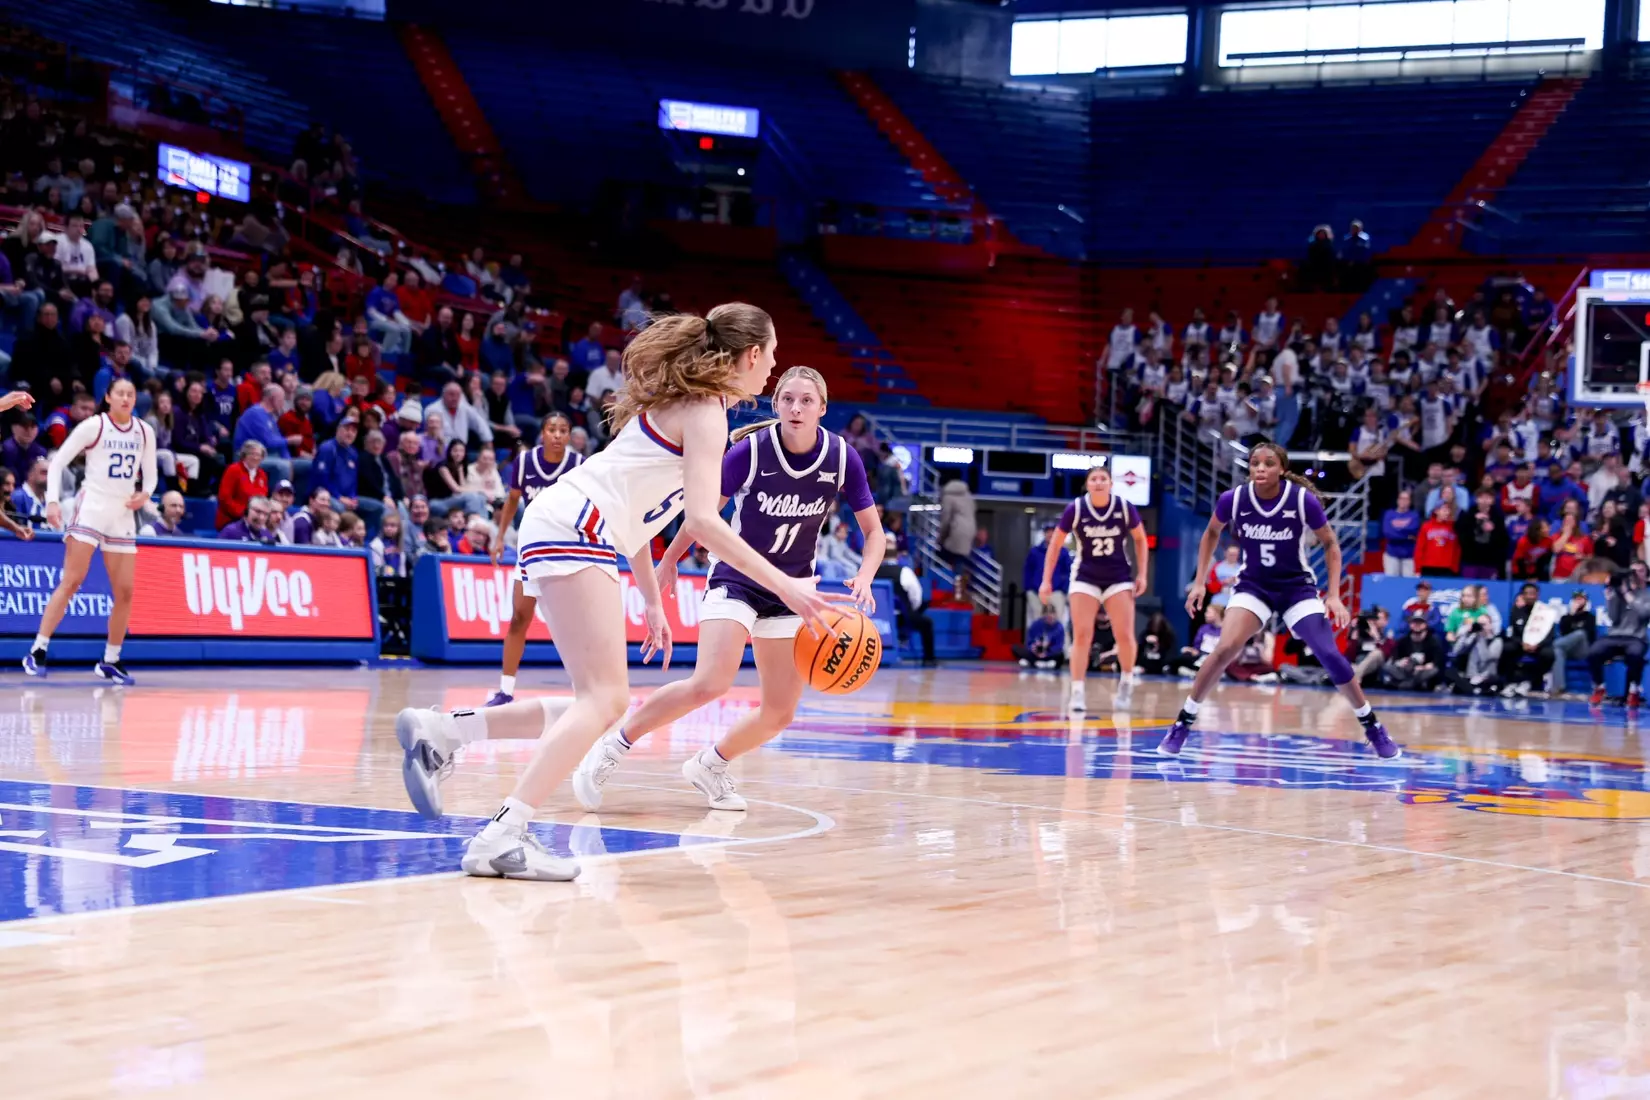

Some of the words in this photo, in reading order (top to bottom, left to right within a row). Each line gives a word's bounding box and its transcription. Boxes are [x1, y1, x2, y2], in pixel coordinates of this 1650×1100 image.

[108, 453, 136, 478] 23
[757, 491, 826, 517] Wildcats
[768, 522, 802, 554] 11
[1242, 522, 1293, 540] Wildcats
[1092, 537, 1115, 557] 23
[1260, 543, 1277, 568] 5
[64, 592, 114, 617] YSTE
[822, 631, 853, 675] NCAA
[841, 637, 876, 689] Wilson
